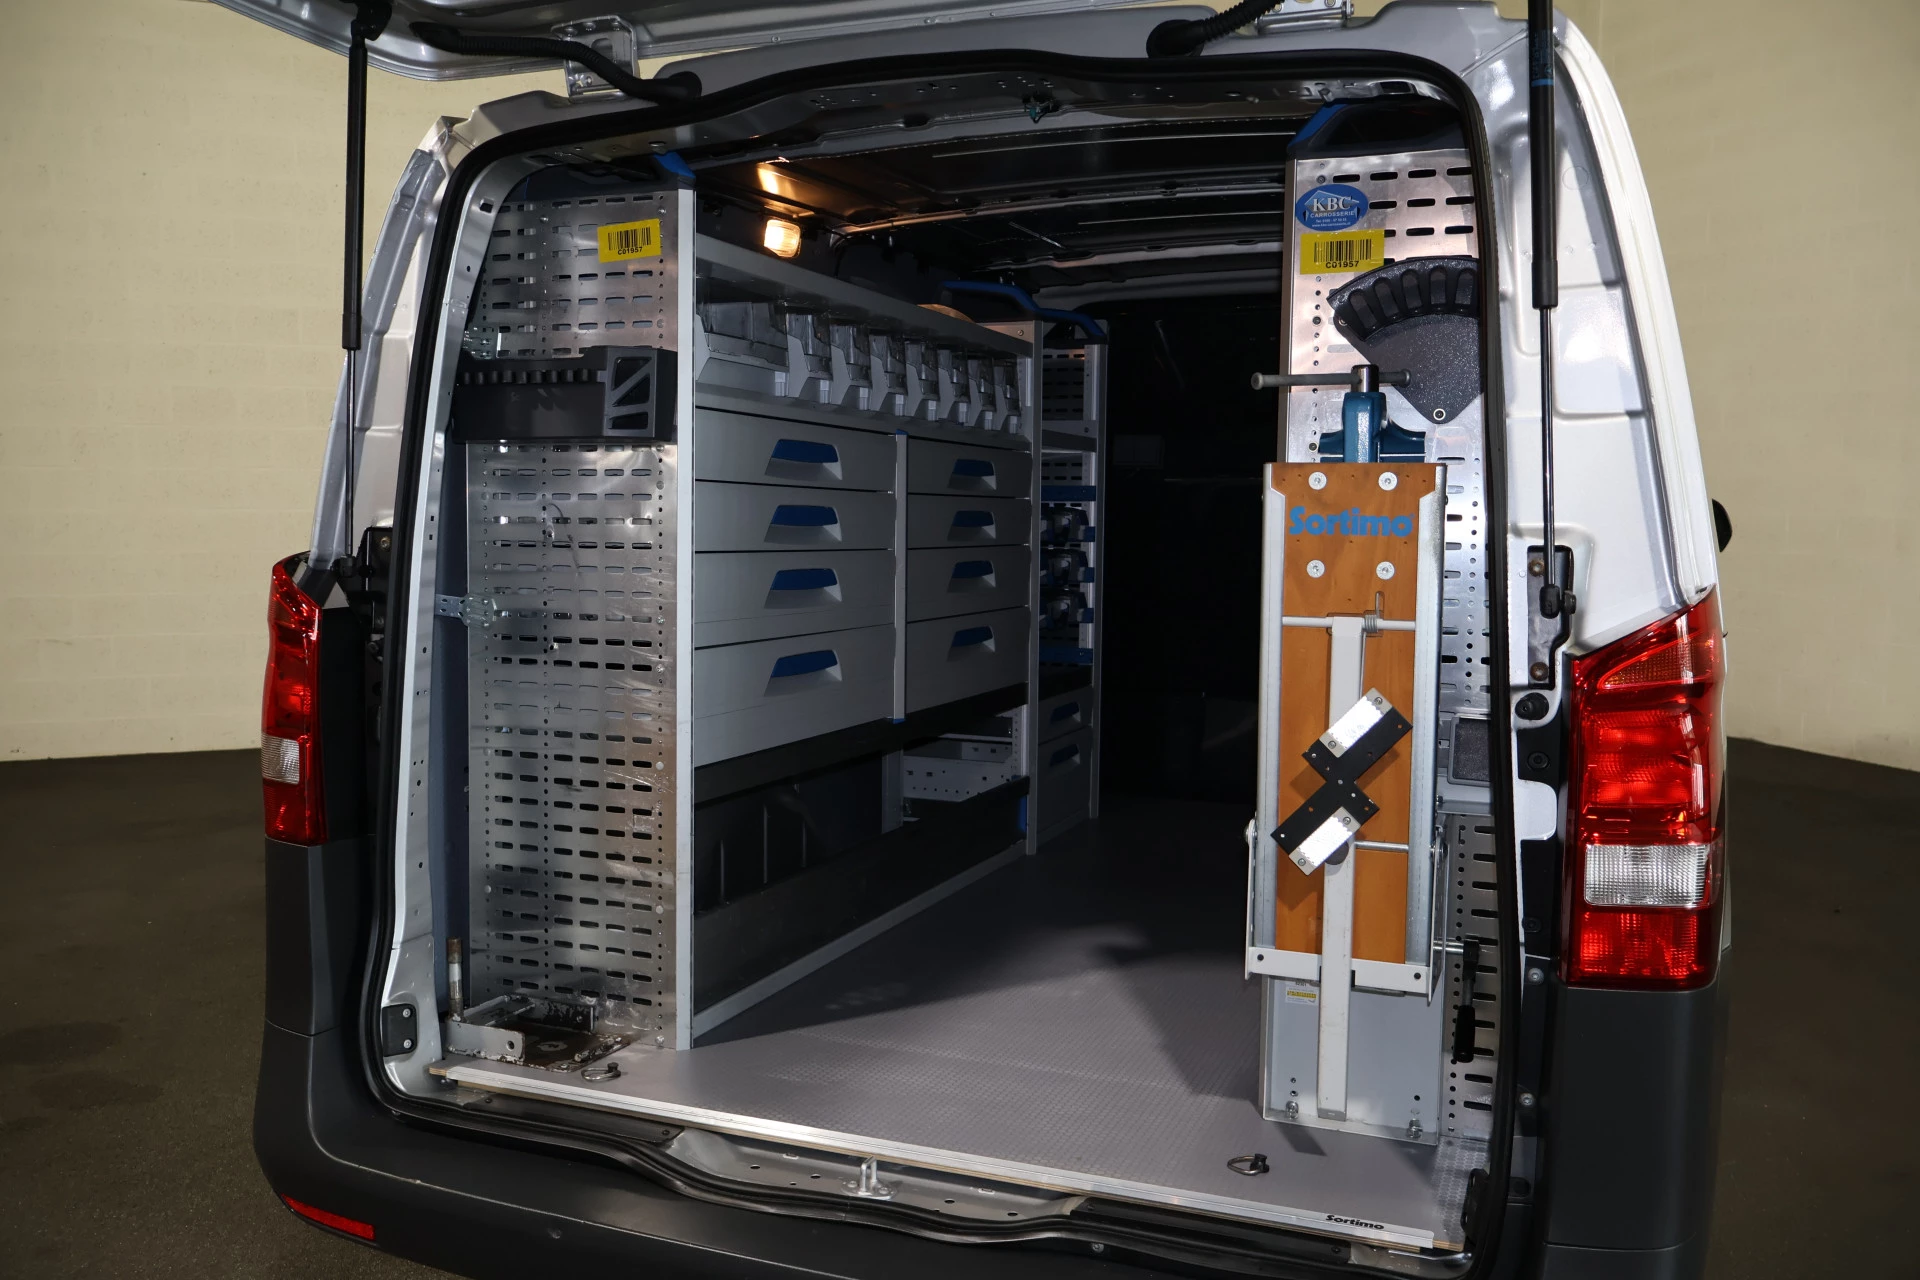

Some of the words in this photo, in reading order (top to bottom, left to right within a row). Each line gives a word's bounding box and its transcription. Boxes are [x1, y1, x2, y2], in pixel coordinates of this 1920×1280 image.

[1312, 196, 1352, 212] KBC
[1310, 211, 1355, 219] CARROSSERIE
[617, 246, 643, 256] C01957
[1325, 260, 1360, 269] C01957
[1288, 505, 1414, 538] Sortimo
[1325, 1214, 1385, 1230] Sortimo
